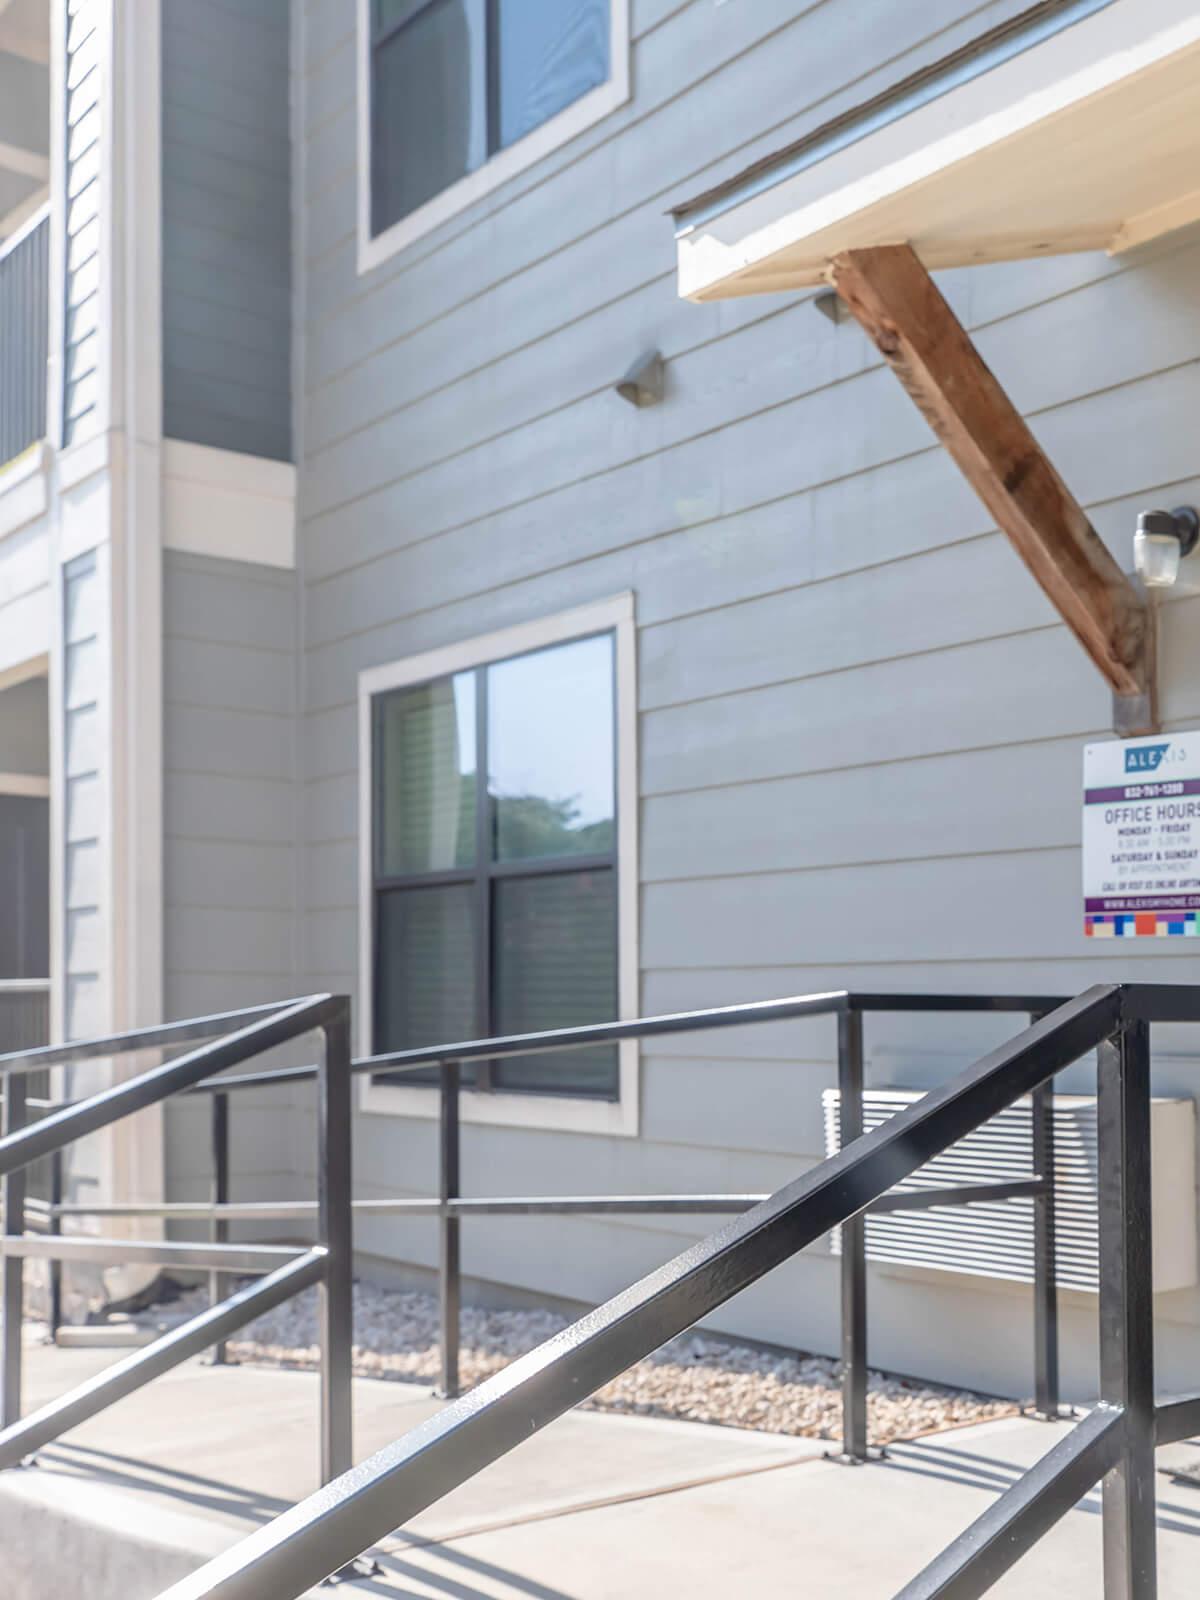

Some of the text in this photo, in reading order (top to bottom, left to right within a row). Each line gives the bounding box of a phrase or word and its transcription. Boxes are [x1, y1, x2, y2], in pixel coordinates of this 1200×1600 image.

[1126, 749, 1187, 768] ALEXIS
[1105, 806, 1152, 825] OFFICE
[1118, 826, 1151, 837] MONDAY
[1161, 823, 1191, 833] FRIDAY
[1111, 849, 1198, 864] SATURDAY & SUNDAY
